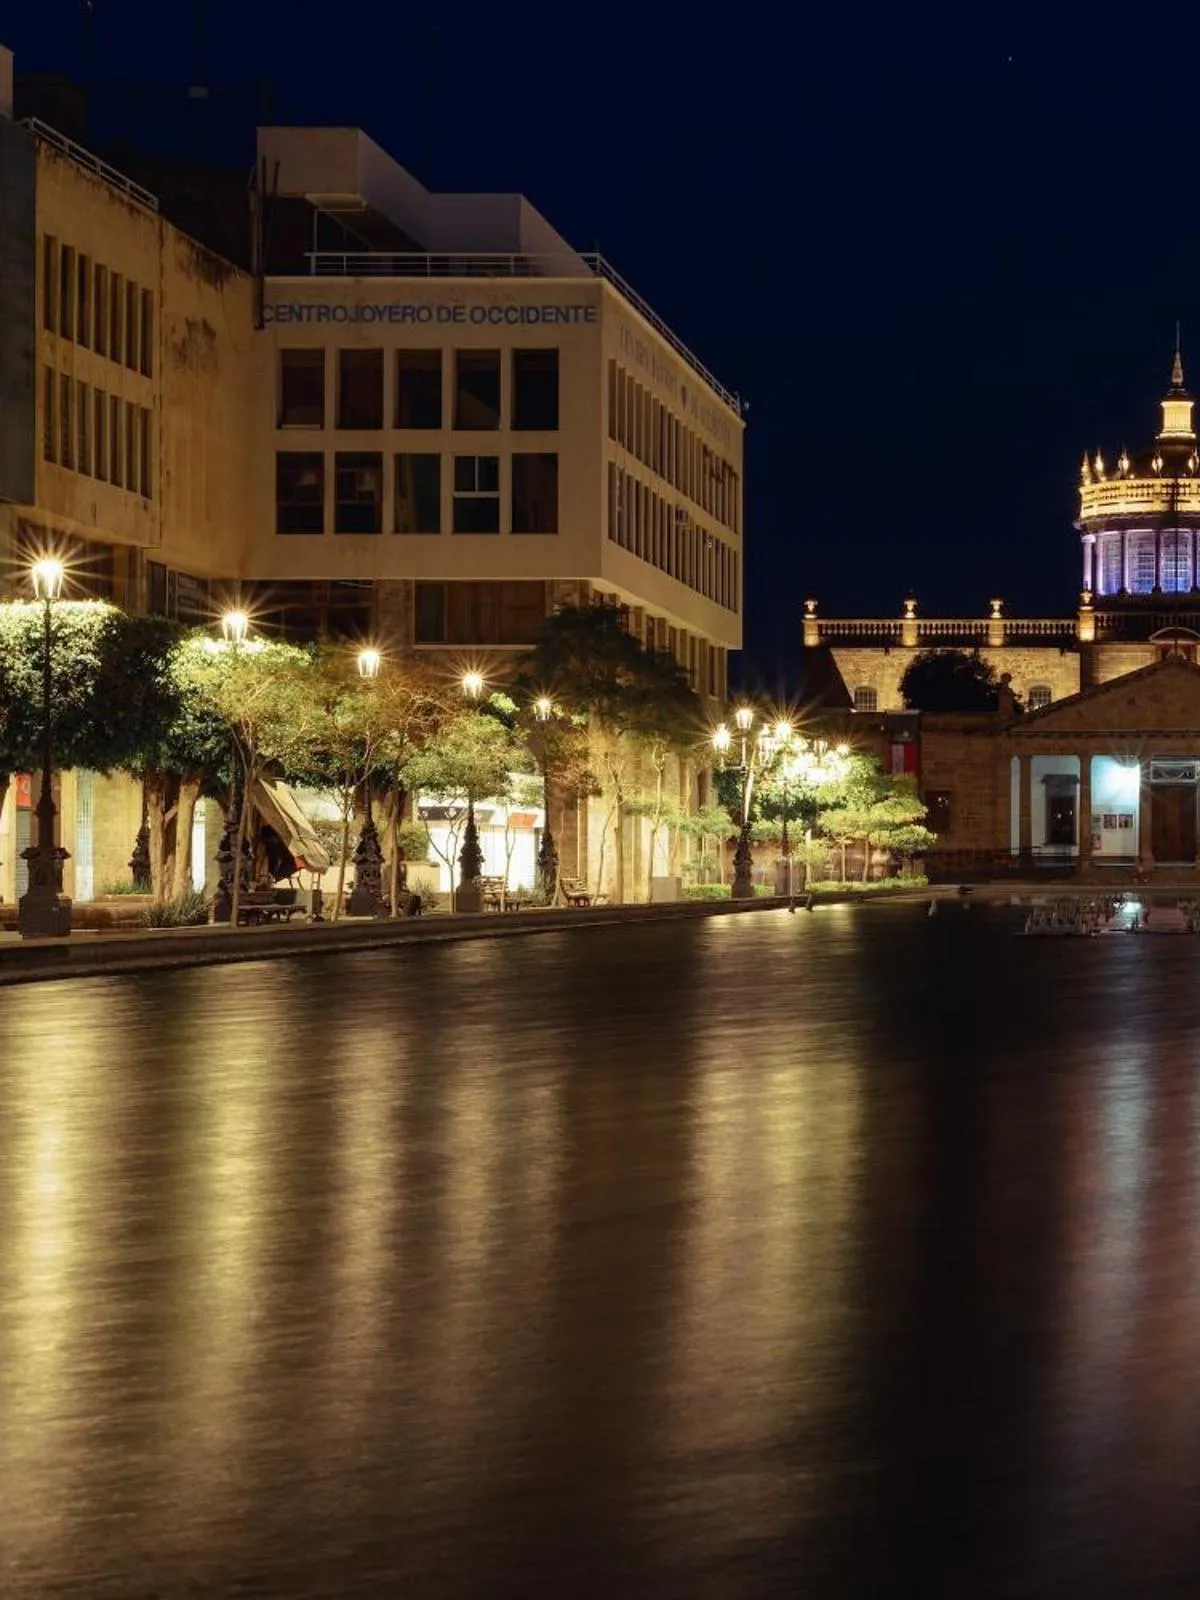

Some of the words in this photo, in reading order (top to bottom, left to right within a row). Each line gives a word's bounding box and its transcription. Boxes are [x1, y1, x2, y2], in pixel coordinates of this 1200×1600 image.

[262, 304, 347, 322] CENTRO
[348, 304, 432, 322] JOYERO
[437, 305, 466, 322] DE
[470, 305, 597, 324] OCCIDENTE
